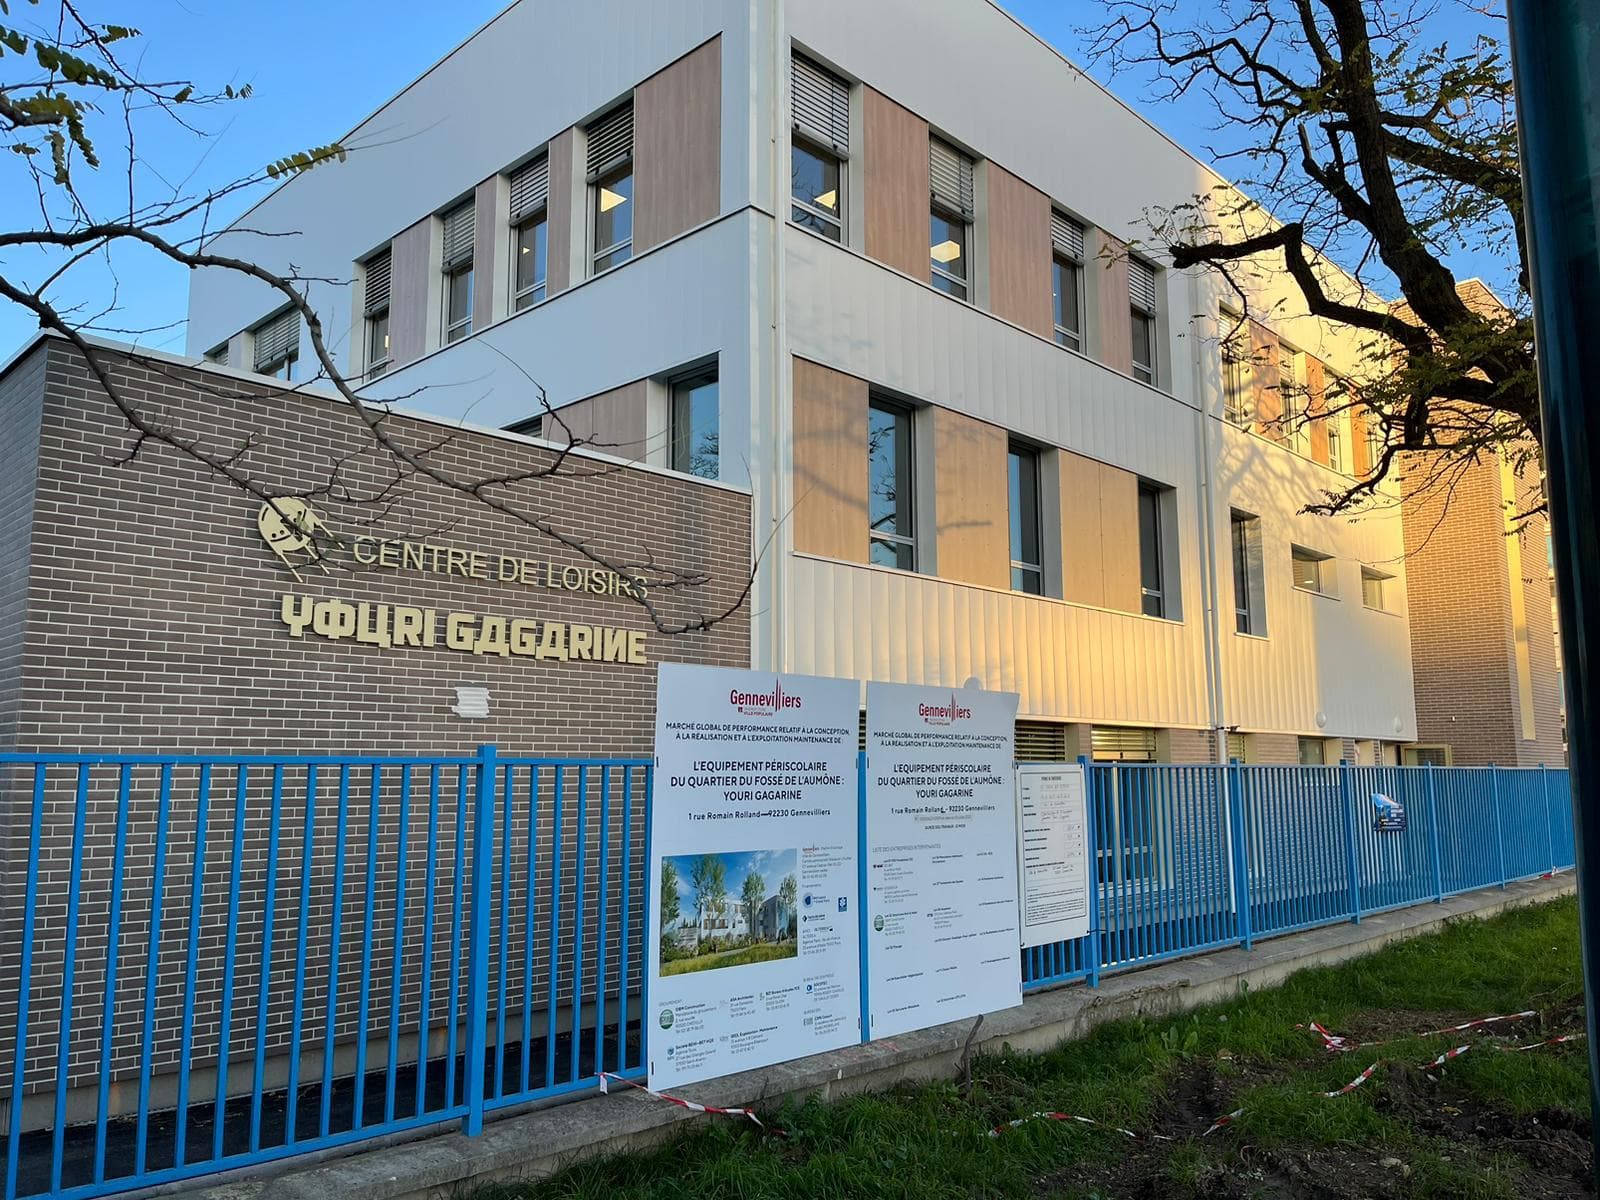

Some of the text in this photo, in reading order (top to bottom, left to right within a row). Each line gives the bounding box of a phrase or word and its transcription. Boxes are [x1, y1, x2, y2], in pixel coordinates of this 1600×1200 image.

[354, 535, 649, 600] CENTRE DE LOISIRS
[730, 675, 802, 712] Gennevilliers
[918, 691, 971, 722] Gennevilliers
[665, 721, 695, 730] MARCHÉ
[695, 723, 722, 732] GLOBAL
[722, 724, 732, 732] DE
[732, 724, 778, 733] PERFORMANCE
[778, 726, 801, 734] RELATIF
[806, 727, 814, 735] LA
[691, 732, 733, 741] RÉALISATION
[733, 734, 741, 742] ET
[793, 735, 834, 744] MAINTENANCE
[895, 732, 913, 740] GLOBAL
[920, 733, 954, 741] PERFORMANCE
[693, 758, 827, 773] L'EQUIPEMENT PÉRISCOLAIRE
[893, 761, 992, 774] L'EQUIPEMENT PÉRISCOLAIRE
[670, 776, 686, 787] DU
[687, 776, 738, 789] QUARTIER
[739, 775, 752, 786] DU
[754, 773, 784, 786] FOSSÉ
[784, 775, 797, 786] DE
[798, 772, 841, 786] L'AUMÔNE
[877, 776, 889, 786] DU
[889, 776, 926, 788] QUARTIER
[926, 776, 937, 786] DU
[938, 774, 960, 786] FOSSÉ
[960, 776, 969, 785] DE
[723, 789, 802, 802] YOURI GAGARINE
[915, 788, 974, 799] YOURI GAGARINE
[688, 812, 692, 820] 1
[707, 811, 734, 820] Romain
[790, 808, 831, 817] Gennevilliers
[904, 806, 924, 814] Romain
[965, 804, 996, 812] Gennevilliers
